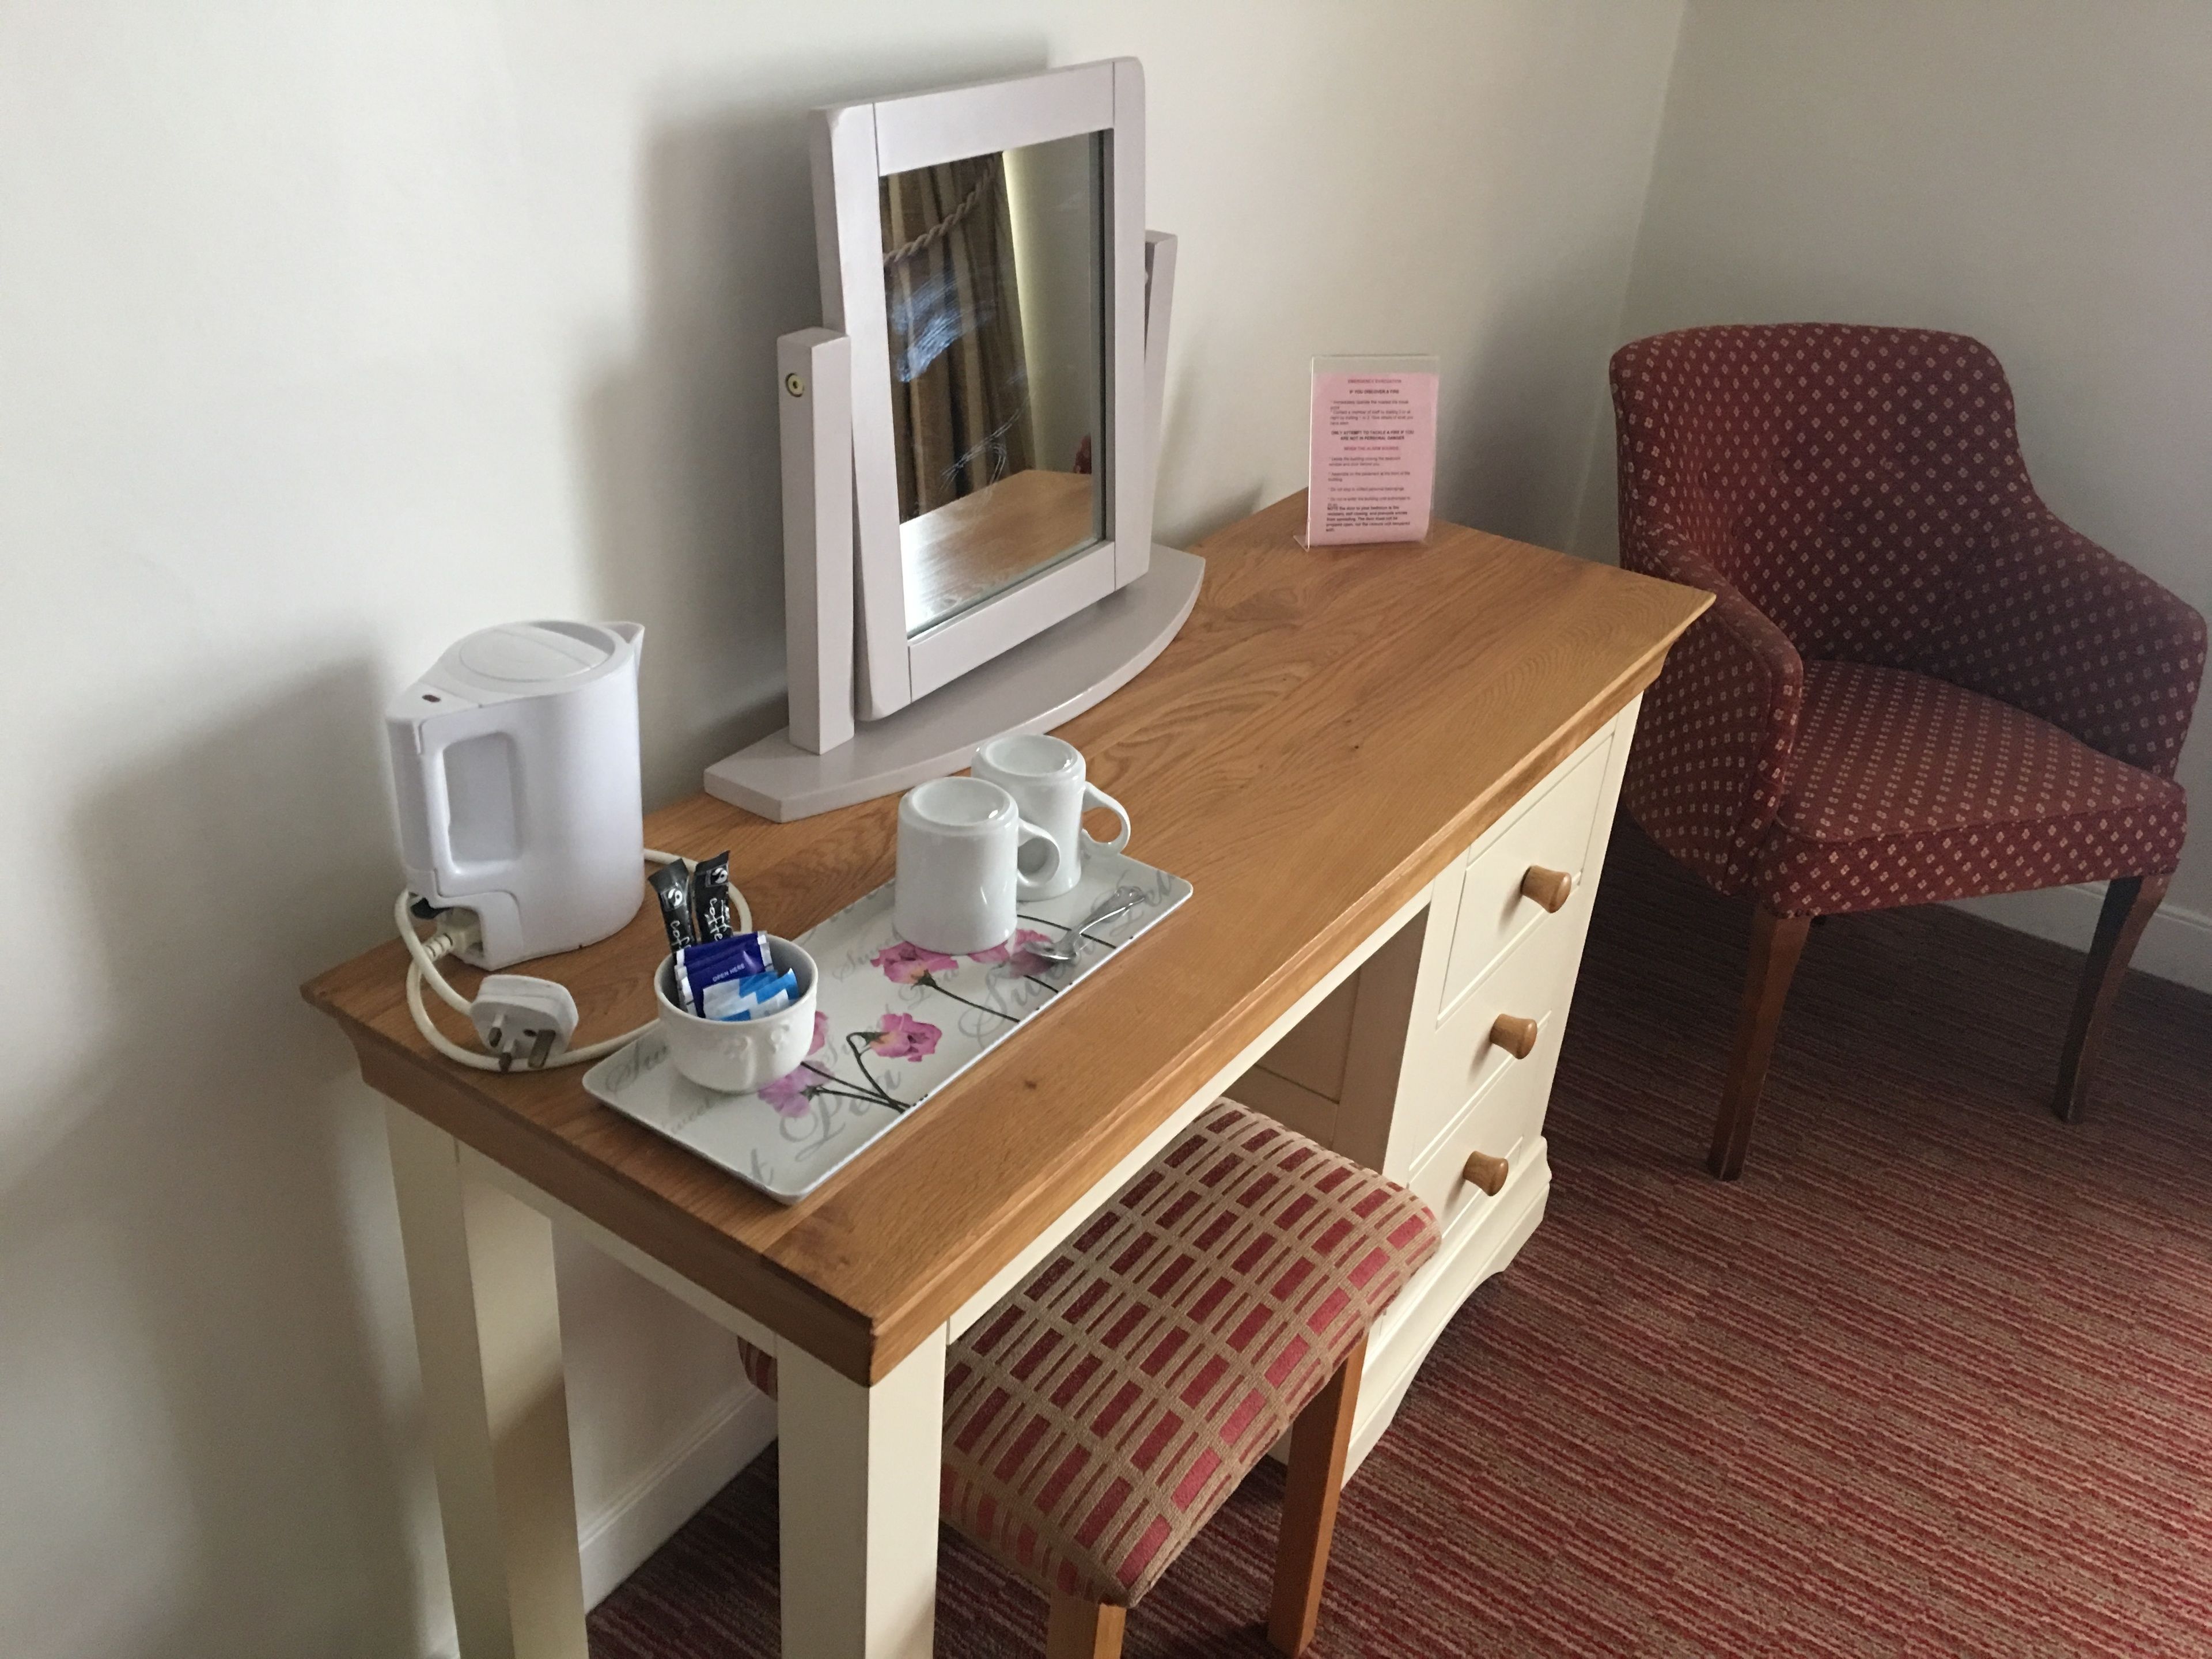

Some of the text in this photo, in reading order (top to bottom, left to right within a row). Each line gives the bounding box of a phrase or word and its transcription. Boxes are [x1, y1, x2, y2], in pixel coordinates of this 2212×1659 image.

[705, 897, 732, 942] coffe
[712, 963, 745, 982] OPEN HERE
